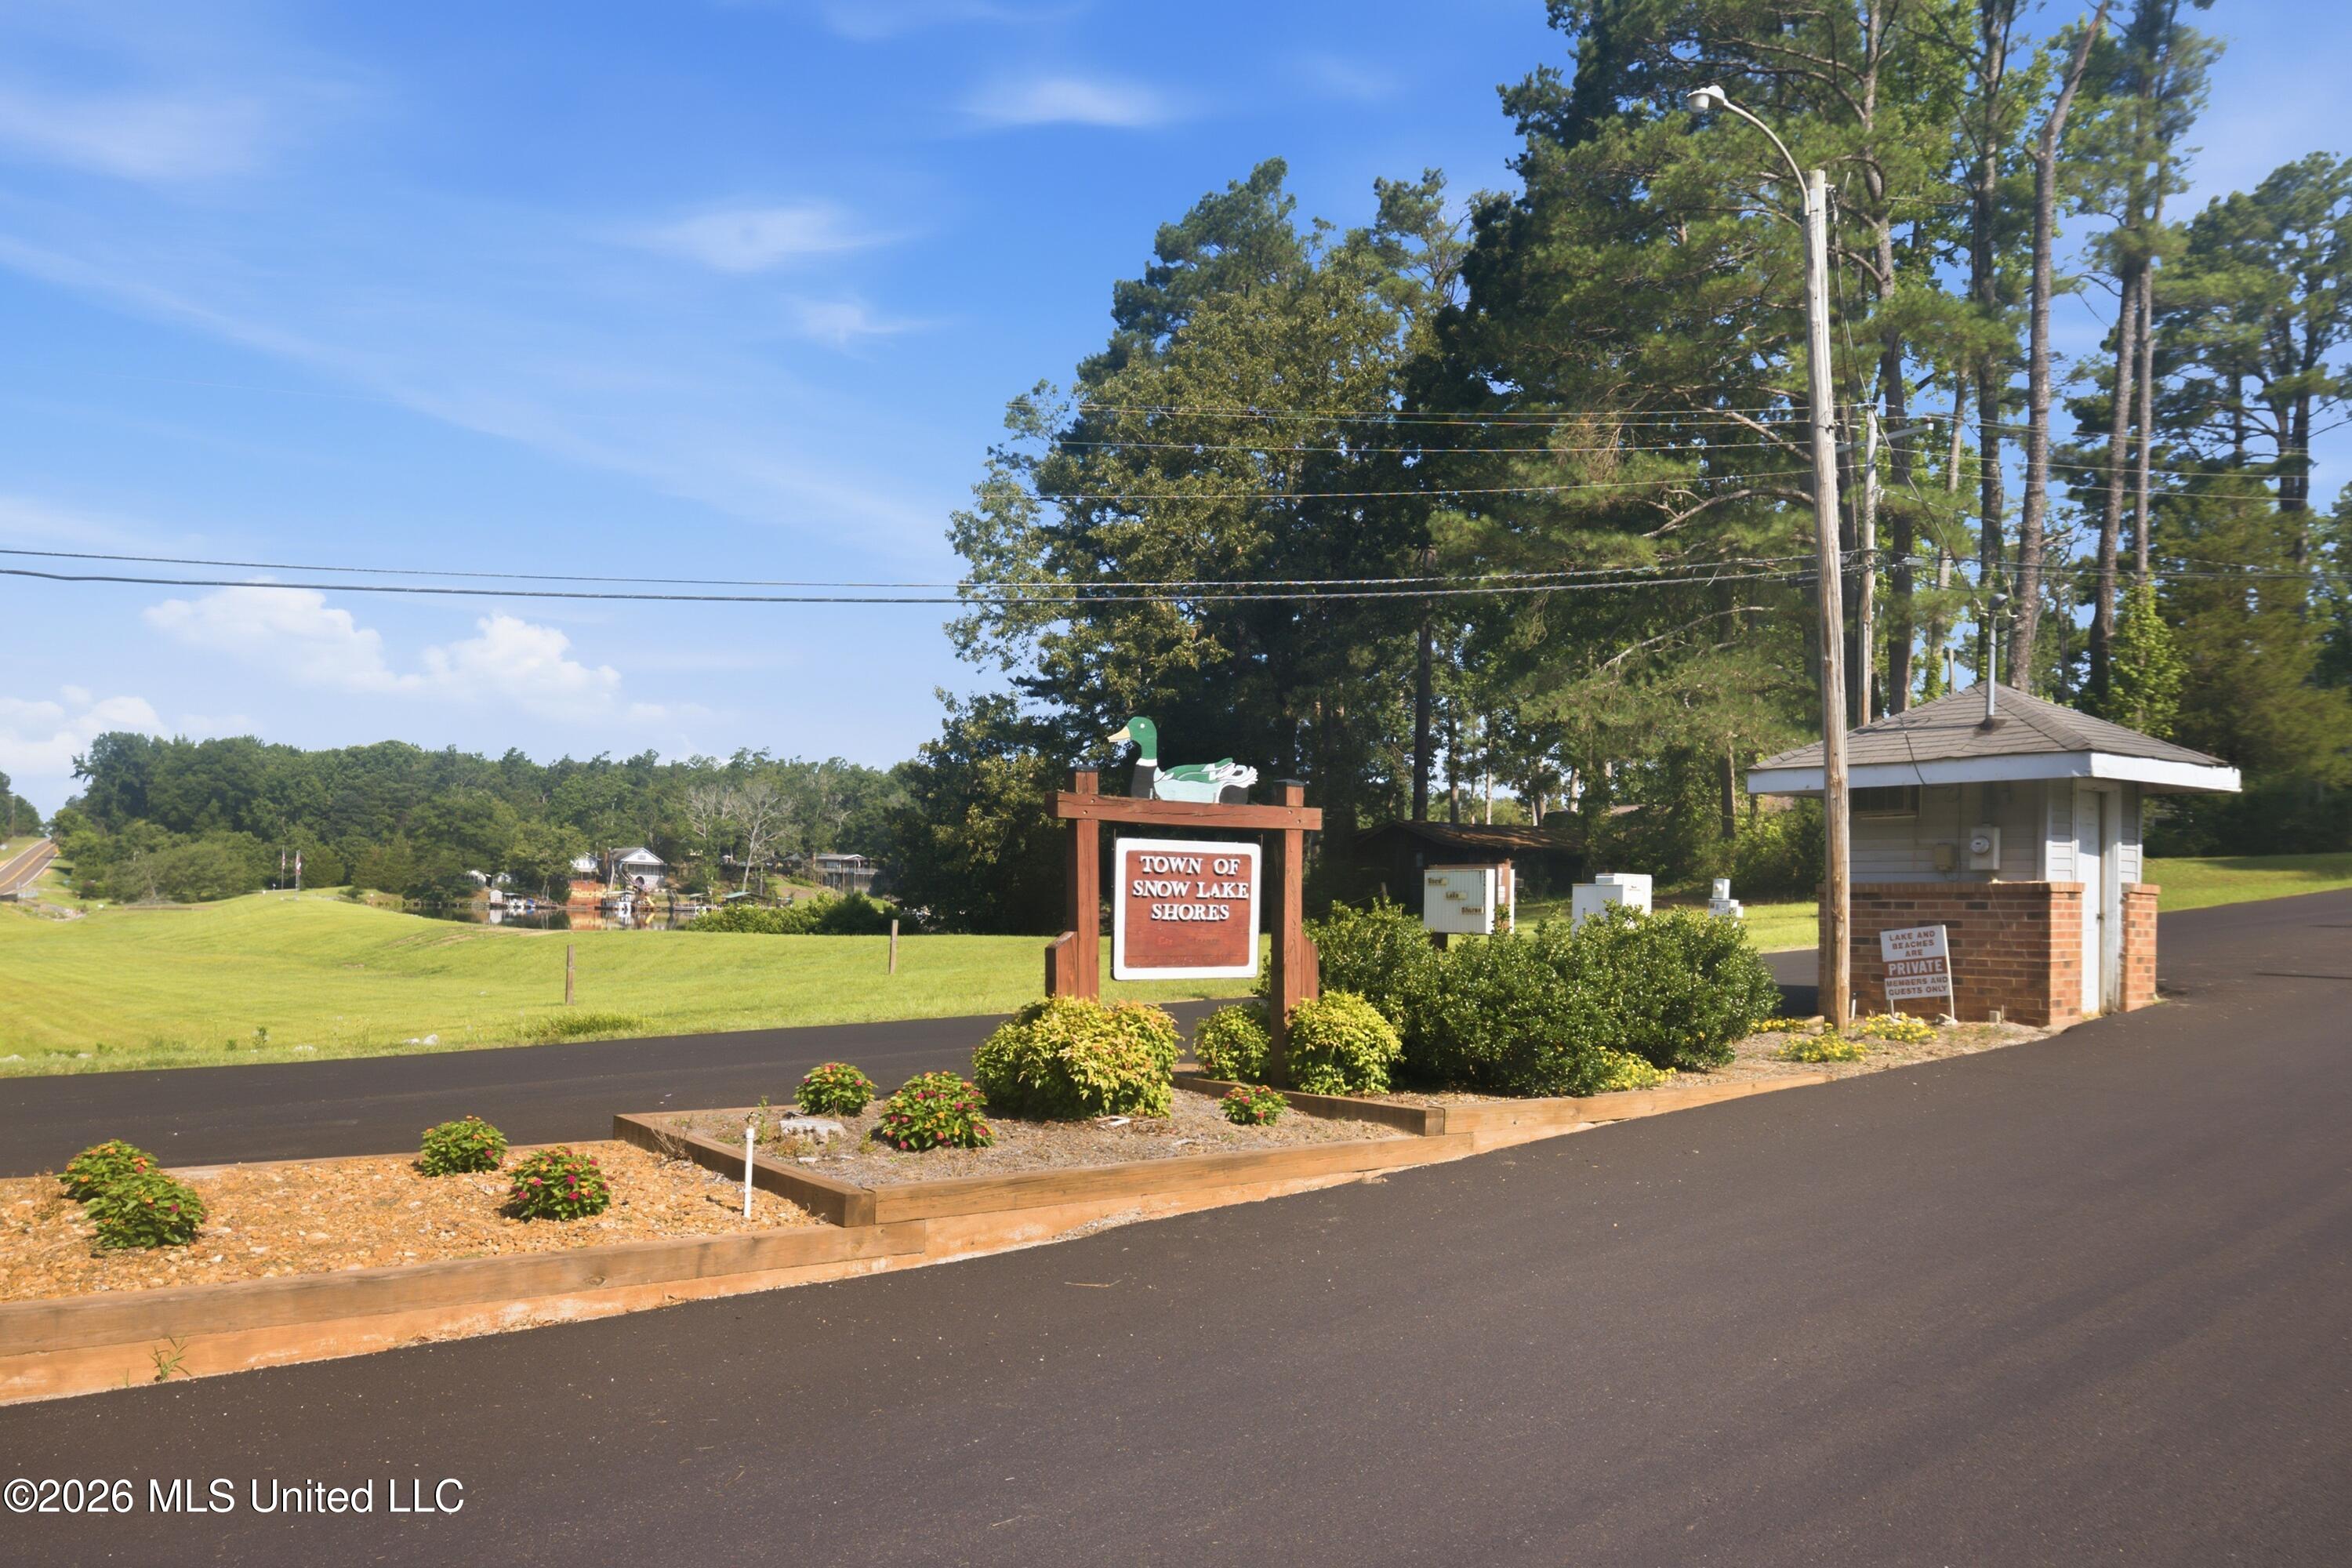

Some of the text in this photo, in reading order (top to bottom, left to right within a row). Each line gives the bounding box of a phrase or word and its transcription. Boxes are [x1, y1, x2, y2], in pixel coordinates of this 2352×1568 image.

[1140, 855, 1241, 876] TOWN OF
[1132, 880, 1249, 899] SNOW LAKE
[1151, 903, 1230, 921] SHORES
[1889, 933, 1913, 942] LAKE
[1892, 939, 1935, 950] BEACHES
[1905, 949, 1923, 957] ARE
[1888, 959, 1943, 976] PRIVATE
[1886, 978, 1928, 987] MEMBERS
[1889, 985, 1947, 996] GUESTS ONLY
